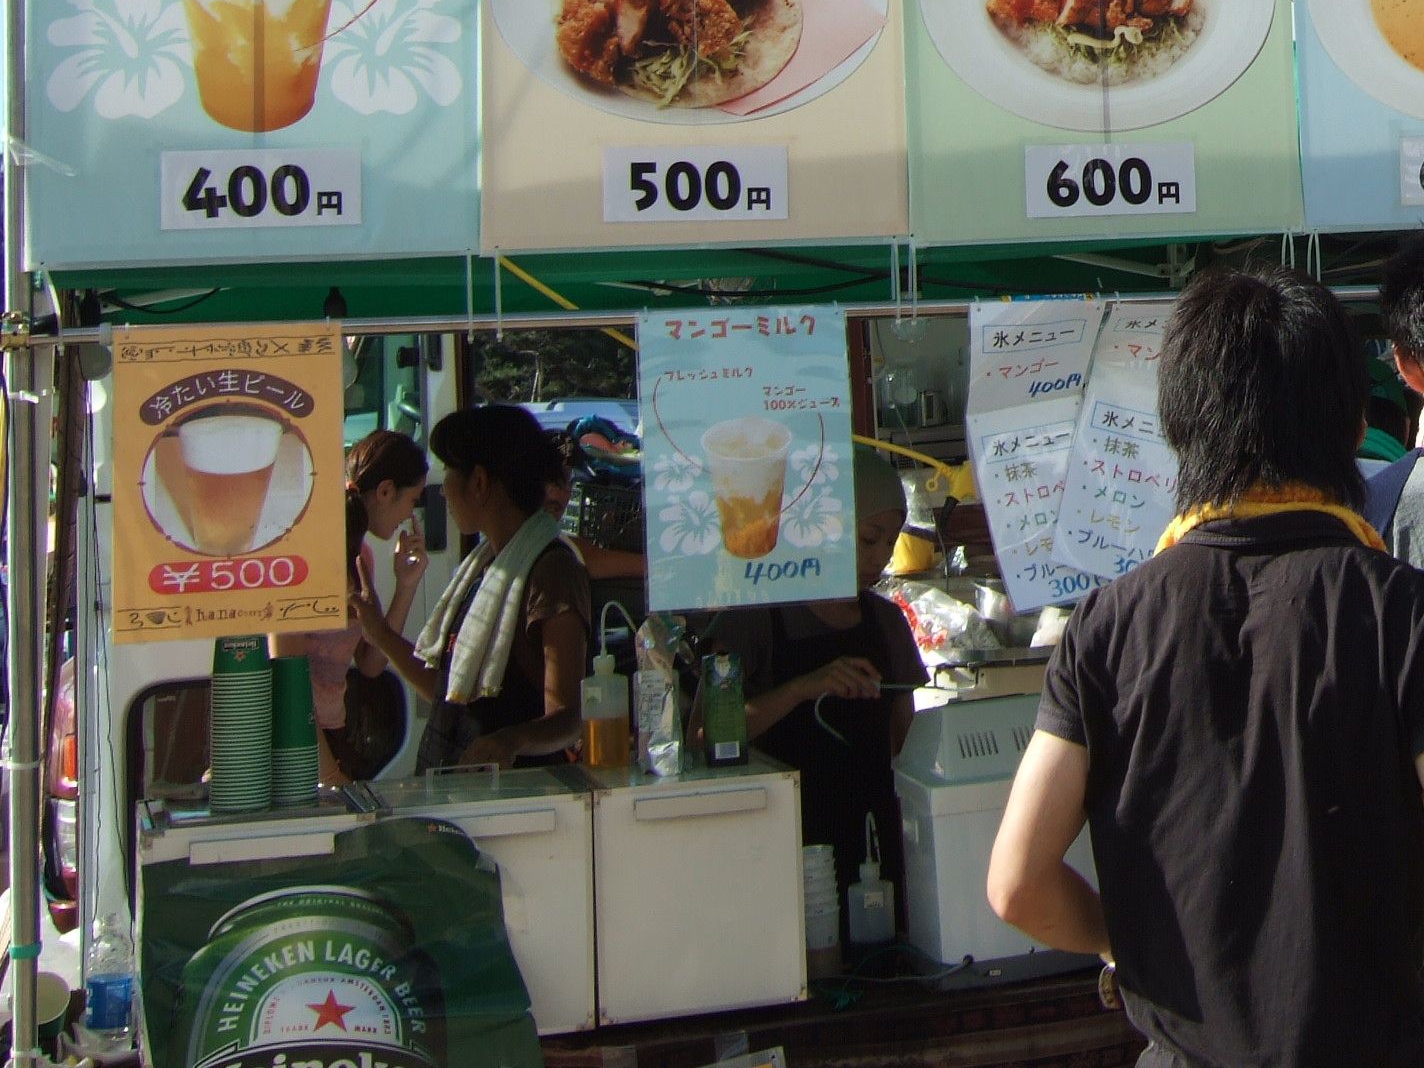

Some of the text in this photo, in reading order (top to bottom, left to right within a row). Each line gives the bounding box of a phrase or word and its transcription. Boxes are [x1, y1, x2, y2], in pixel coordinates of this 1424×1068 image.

[182, 163, 343, 218] 400円
[629, 159, 772, 213] 500円
[1045, 156, 1181, 208] 600円
[664, 314, 817, 340] マンゴーミルク
[993, 329, 1075, 349] 氷メニュー
[1127, 343, 1161, 361] マン
[150, 369, 305, 419] 冷たい生ビール
[762, 386, 806, 396] マンゴー
[1028, 373, 1082, 398] 400円
[1102, 410, 1165, 437] 氷メニ
[993, 432, 1070, 457] 氷メニュー
[1091, 459, 1179, 494] ストロベリ
[1024, 538, 1053, 556] レモ
[1078, 529, 1156, 560] ブルーハ
[744, 557, 821, 585] 400円
[1023, 563, 1068, 582] ブルー
[1049, 573, 1101, 598] 300
[217, 939, 428, 1035] HEINEKEN LAGER BEER
